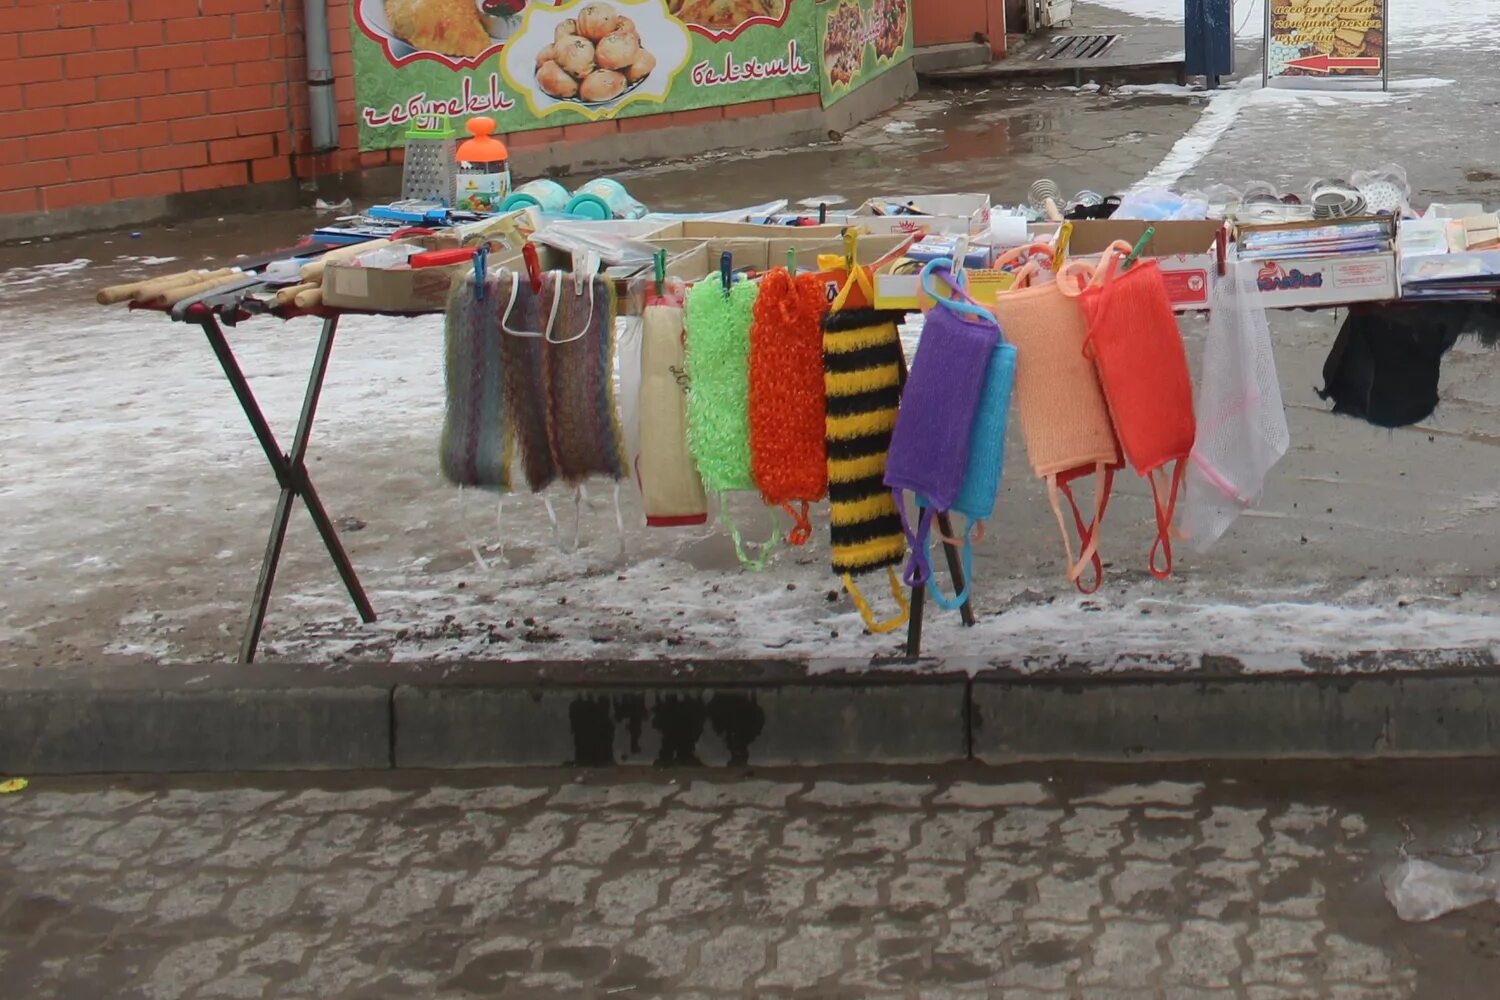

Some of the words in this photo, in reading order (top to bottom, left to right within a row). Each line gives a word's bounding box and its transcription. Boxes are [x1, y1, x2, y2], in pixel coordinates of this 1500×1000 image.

[1275, 5, 1377, 15] ассортимент
[1275, 20, 1380, 29] кондитерских
[1275, 33, 1335, 45] изделий
[691, 41, 812, 88] беляши
[362, 75, 516, 128] чебуреки
